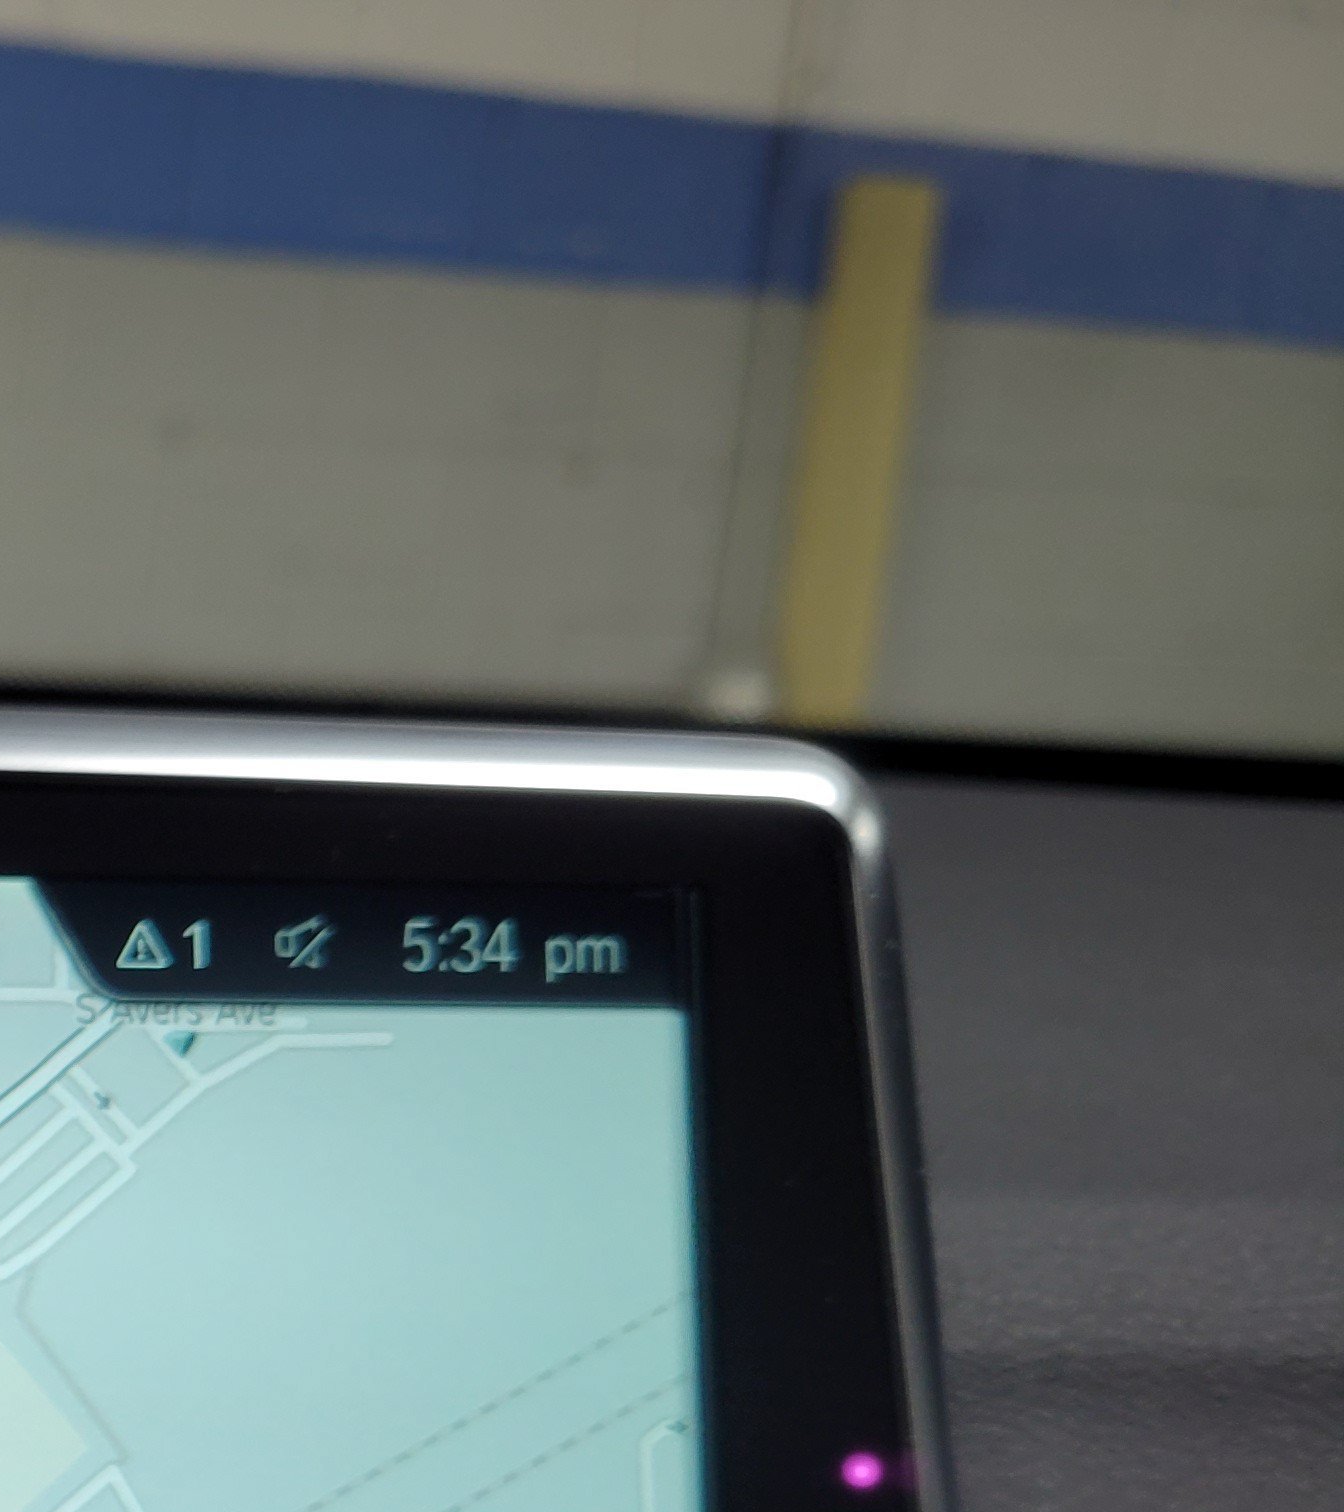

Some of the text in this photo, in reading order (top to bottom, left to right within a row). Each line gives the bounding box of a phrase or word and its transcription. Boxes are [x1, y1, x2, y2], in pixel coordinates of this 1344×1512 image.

[182, 919, 212, 970] 1
[402, 916, 630, 984] 5:34 pm
